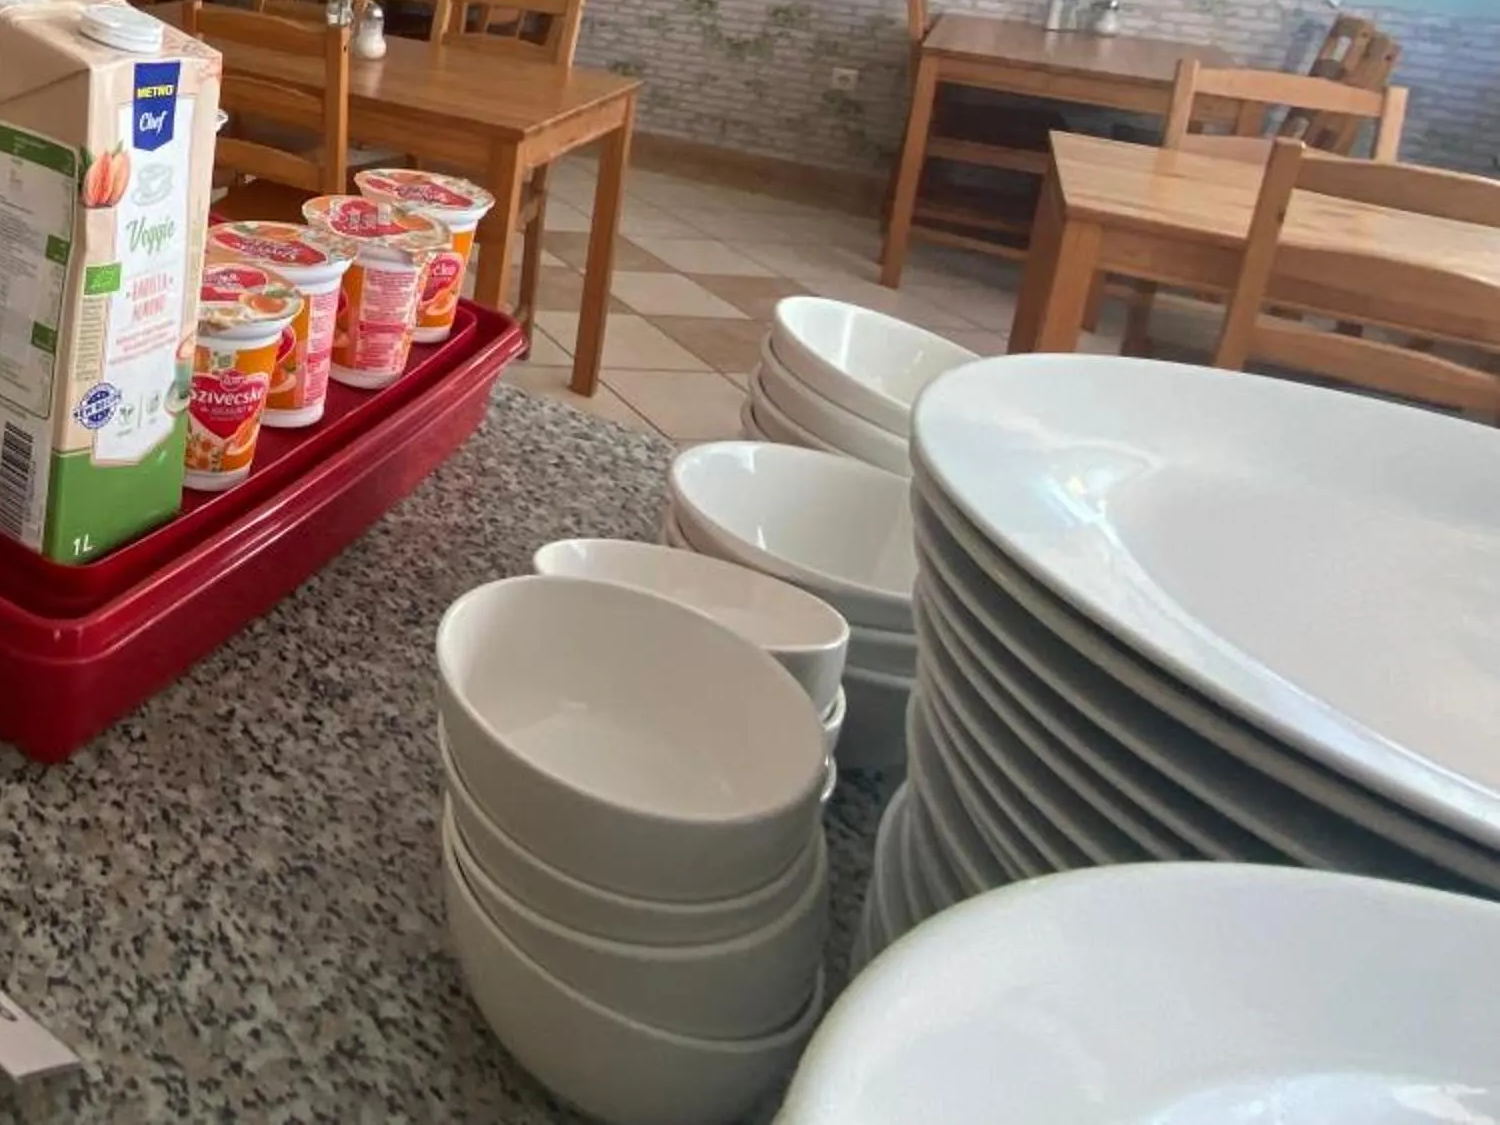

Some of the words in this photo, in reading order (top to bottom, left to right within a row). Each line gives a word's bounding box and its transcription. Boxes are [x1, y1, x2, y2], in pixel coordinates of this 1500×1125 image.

[137, 84, 175, 99] METRO
[139, 111, 169, 136] Chef
[125, 216, 176, 255] Veggie
